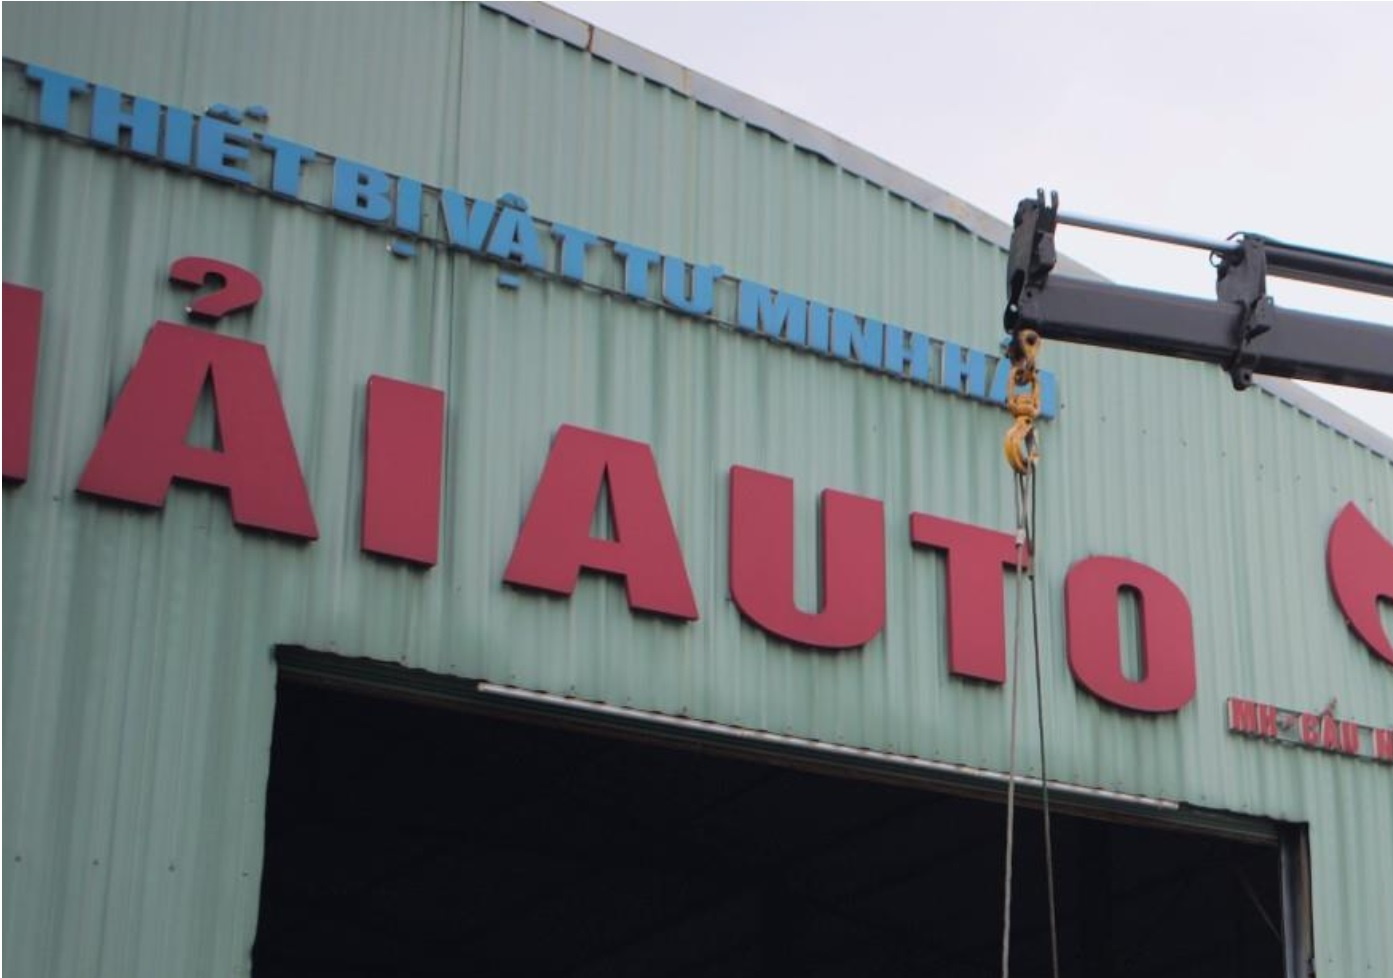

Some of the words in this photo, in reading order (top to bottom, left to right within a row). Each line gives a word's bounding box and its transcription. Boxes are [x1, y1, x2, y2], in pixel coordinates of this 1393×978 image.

[26, 63, 317, 202] THIẾT
[331, 154, 423, 257] BỊ
[442, 187, 600, 290] VẬT
[738, 280, 929, 382] MINH
[502, 422, 1198, 714] AUTO
